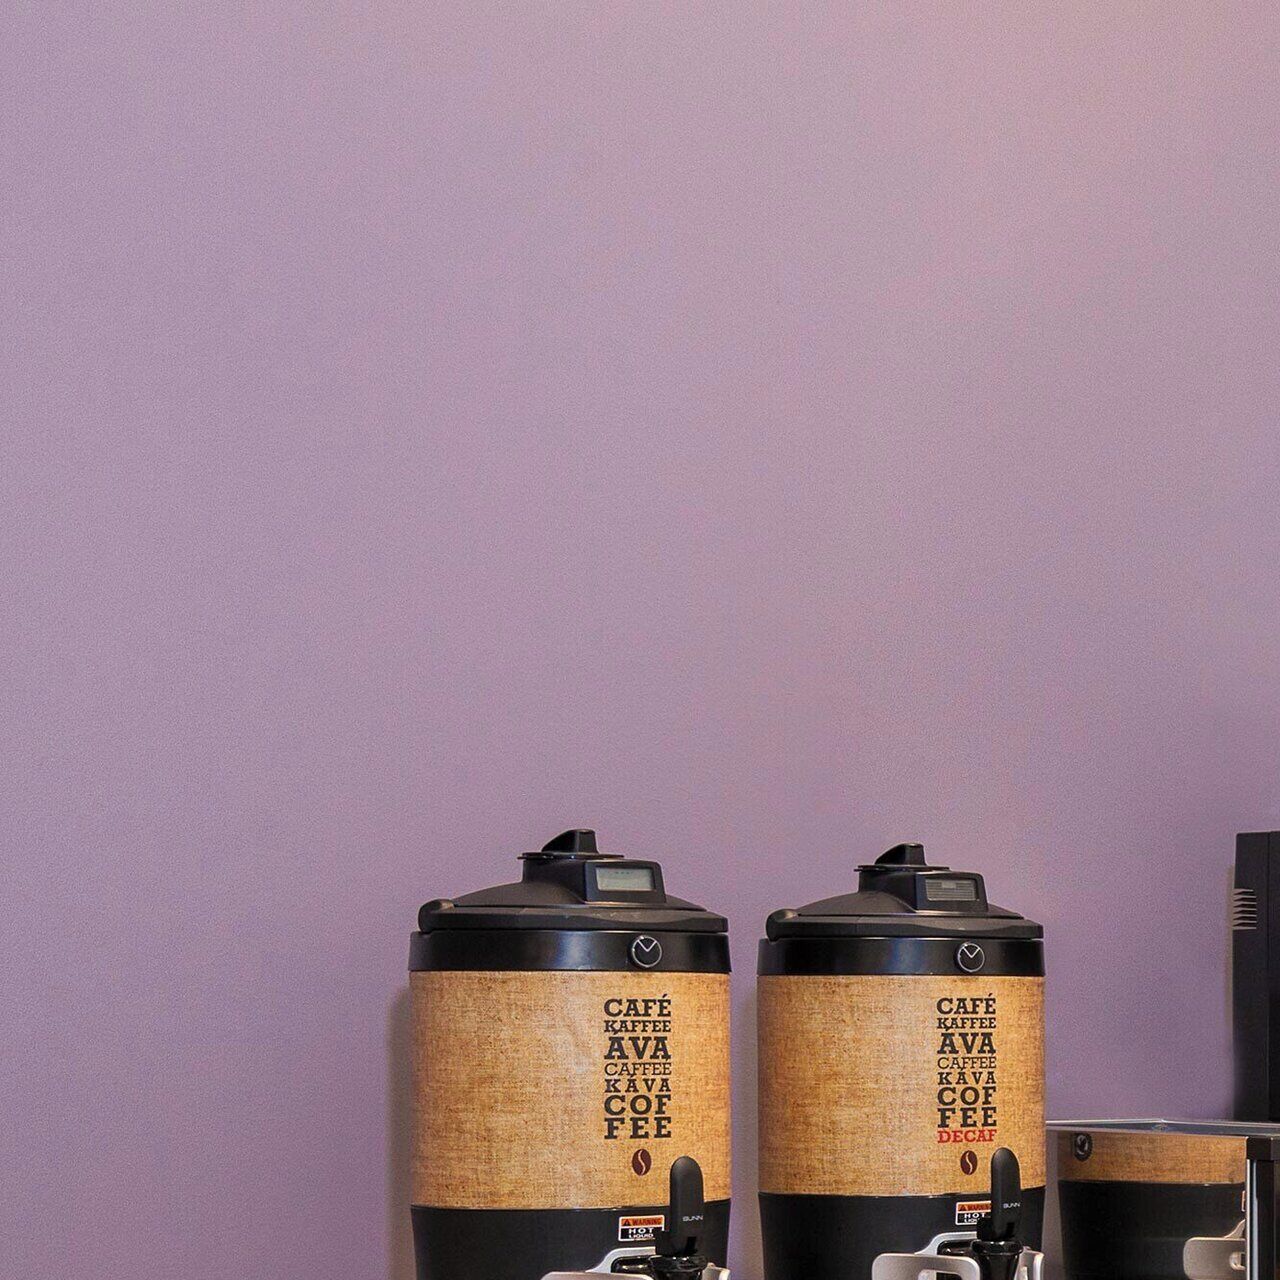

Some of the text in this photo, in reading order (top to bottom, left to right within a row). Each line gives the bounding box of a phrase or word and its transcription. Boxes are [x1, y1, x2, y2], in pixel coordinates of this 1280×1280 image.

[604, 993, 671, 1017] CAFÉ
[936, 993, 996, 1015] CAFÉ
[604, 1020, 671, 1032] KAFFEE
[937, 1017, 996, 1029] KAFFEE
[604, 1094, 671, 1115] COF
[937, 1086, 996, 1106] COF
[604, 1116, 671, 1139] FEE
[937, 1106, 997, 1128] FEE
[937, 1129, 997, 1144] DECAF
